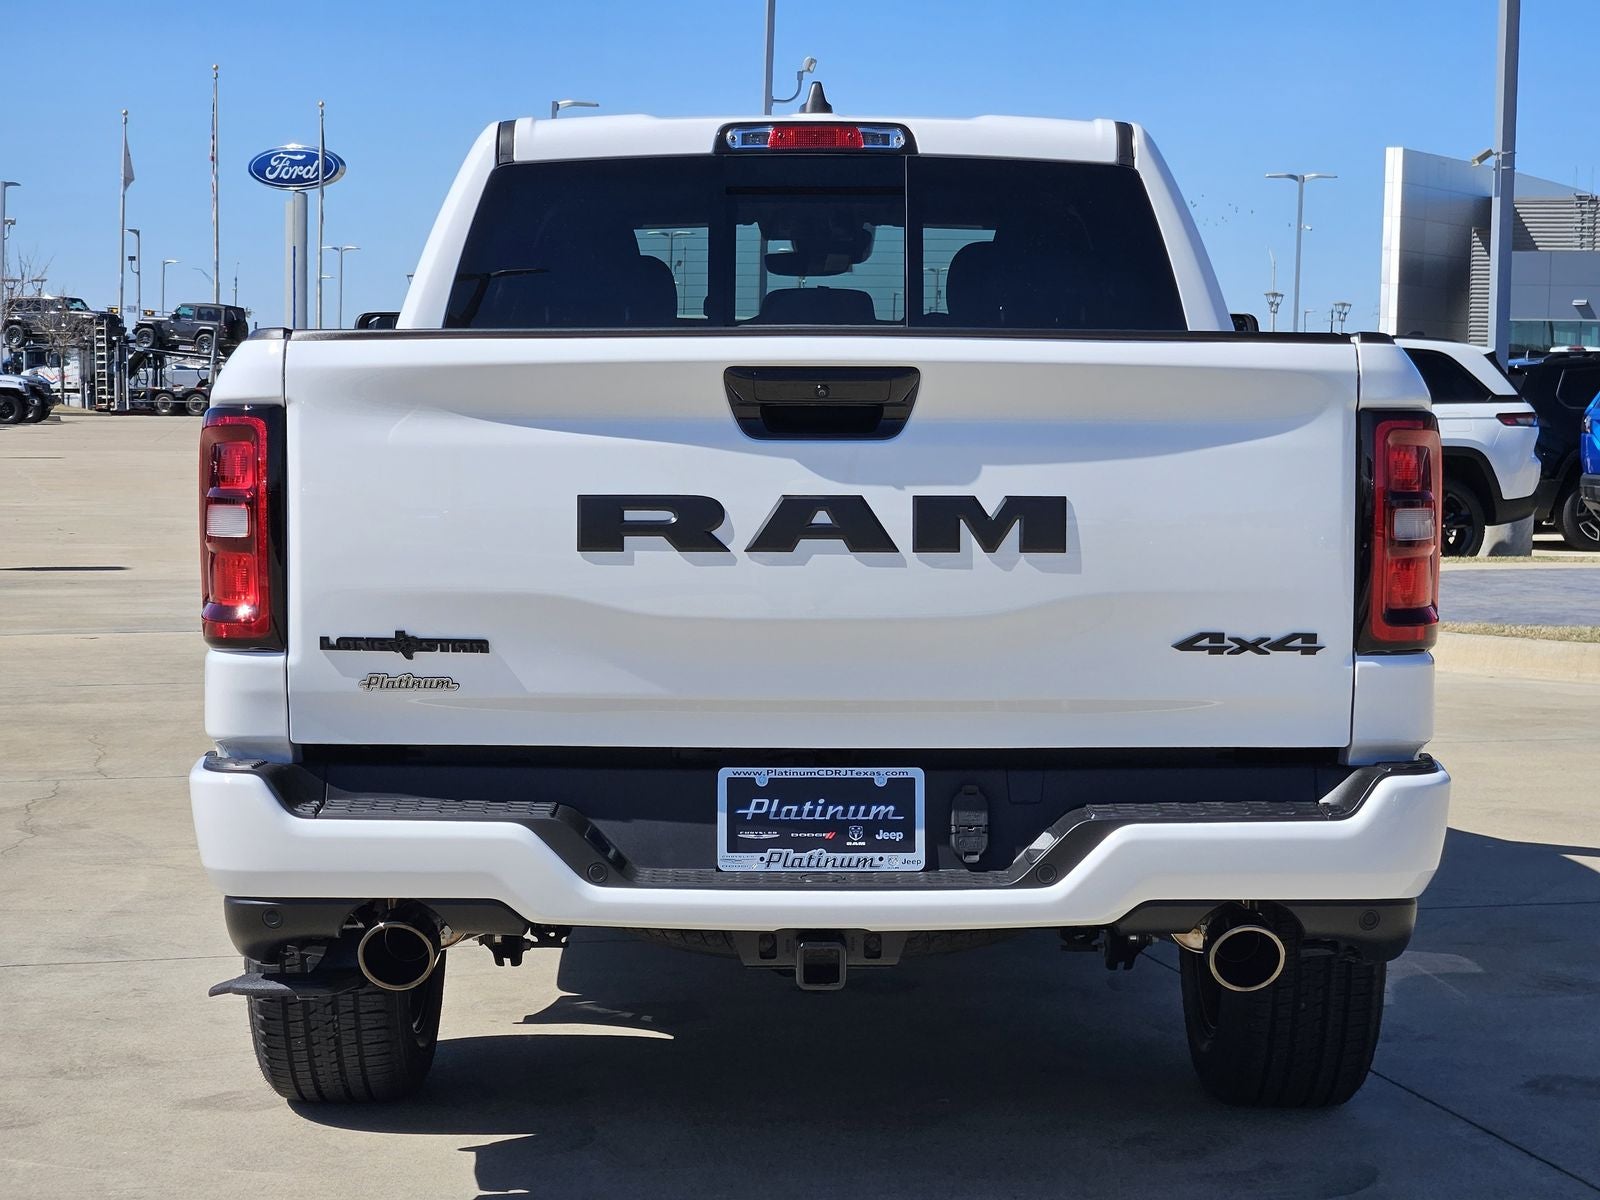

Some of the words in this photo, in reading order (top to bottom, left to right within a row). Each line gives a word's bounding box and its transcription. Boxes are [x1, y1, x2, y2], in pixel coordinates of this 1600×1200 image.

[265, 152, 319, 180] Ford
[577, 494, 1067, 554] RAM
[416, 637, 490, 654] STAR
[1171, 631, 1326, 656] 4x4
[359, 673, 460, 691] Platinum
[731, 768, 910, 778] www.PlatinumCDRJTexas.com
[735, 797, 905, 821] Platinum
[875, 829, 904, 842] Jeep
[765, 849, 884, 869] Platinum
[901, 858, 922, 867] Jeep
